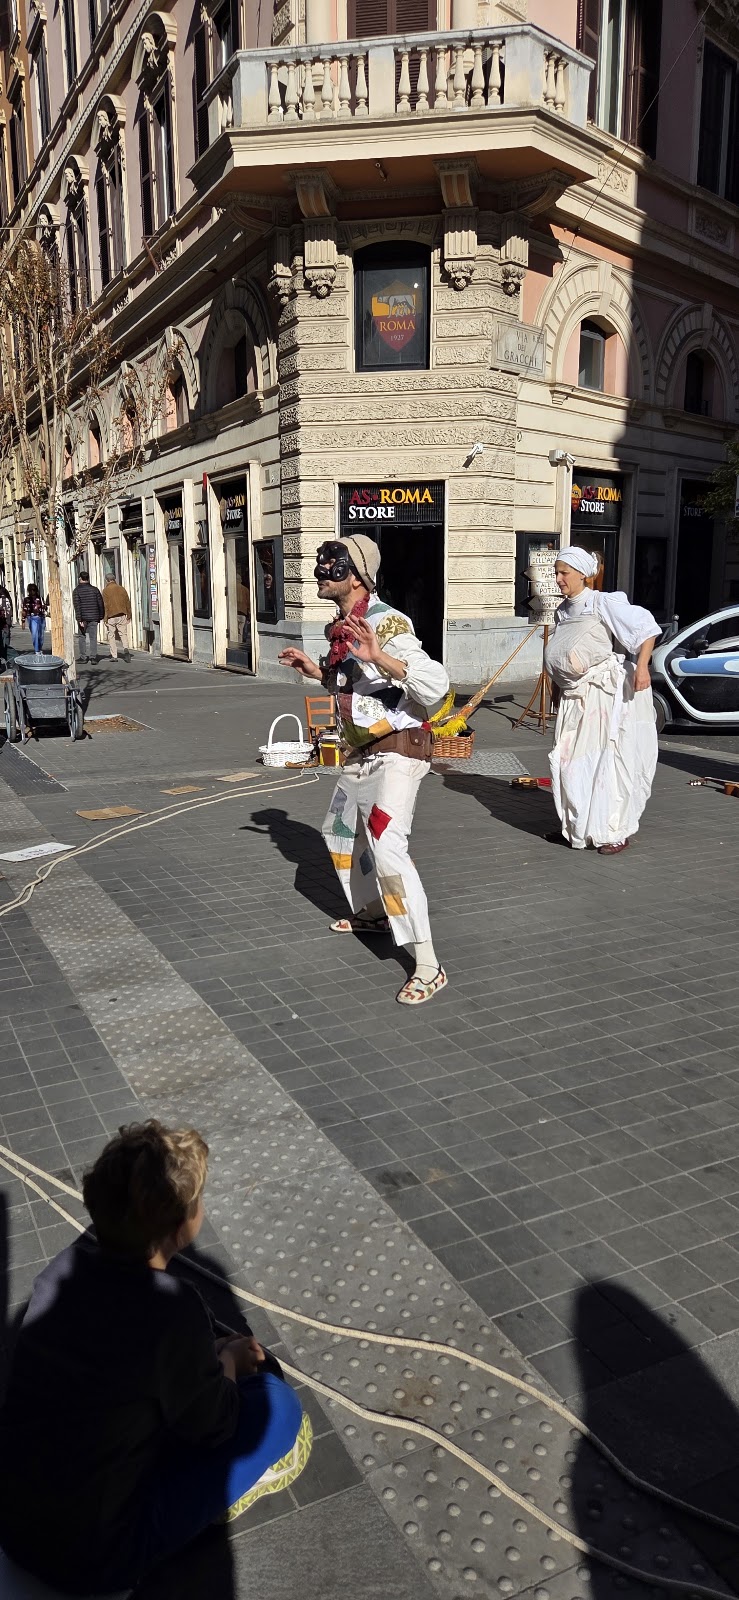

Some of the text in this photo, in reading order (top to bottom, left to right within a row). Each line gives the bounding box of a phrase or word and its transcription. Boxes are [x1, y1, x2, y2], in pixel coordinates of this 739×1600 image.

[380, 320, 415, 332] ROMA
[516, 331, 529, 343] VIA
[504, 350, 538, 367] GRACCHI
[380, 488, 434, 504] ROMA
[348, 505, 395, 519] STORE
[581, 499, 605, 513] STORE
